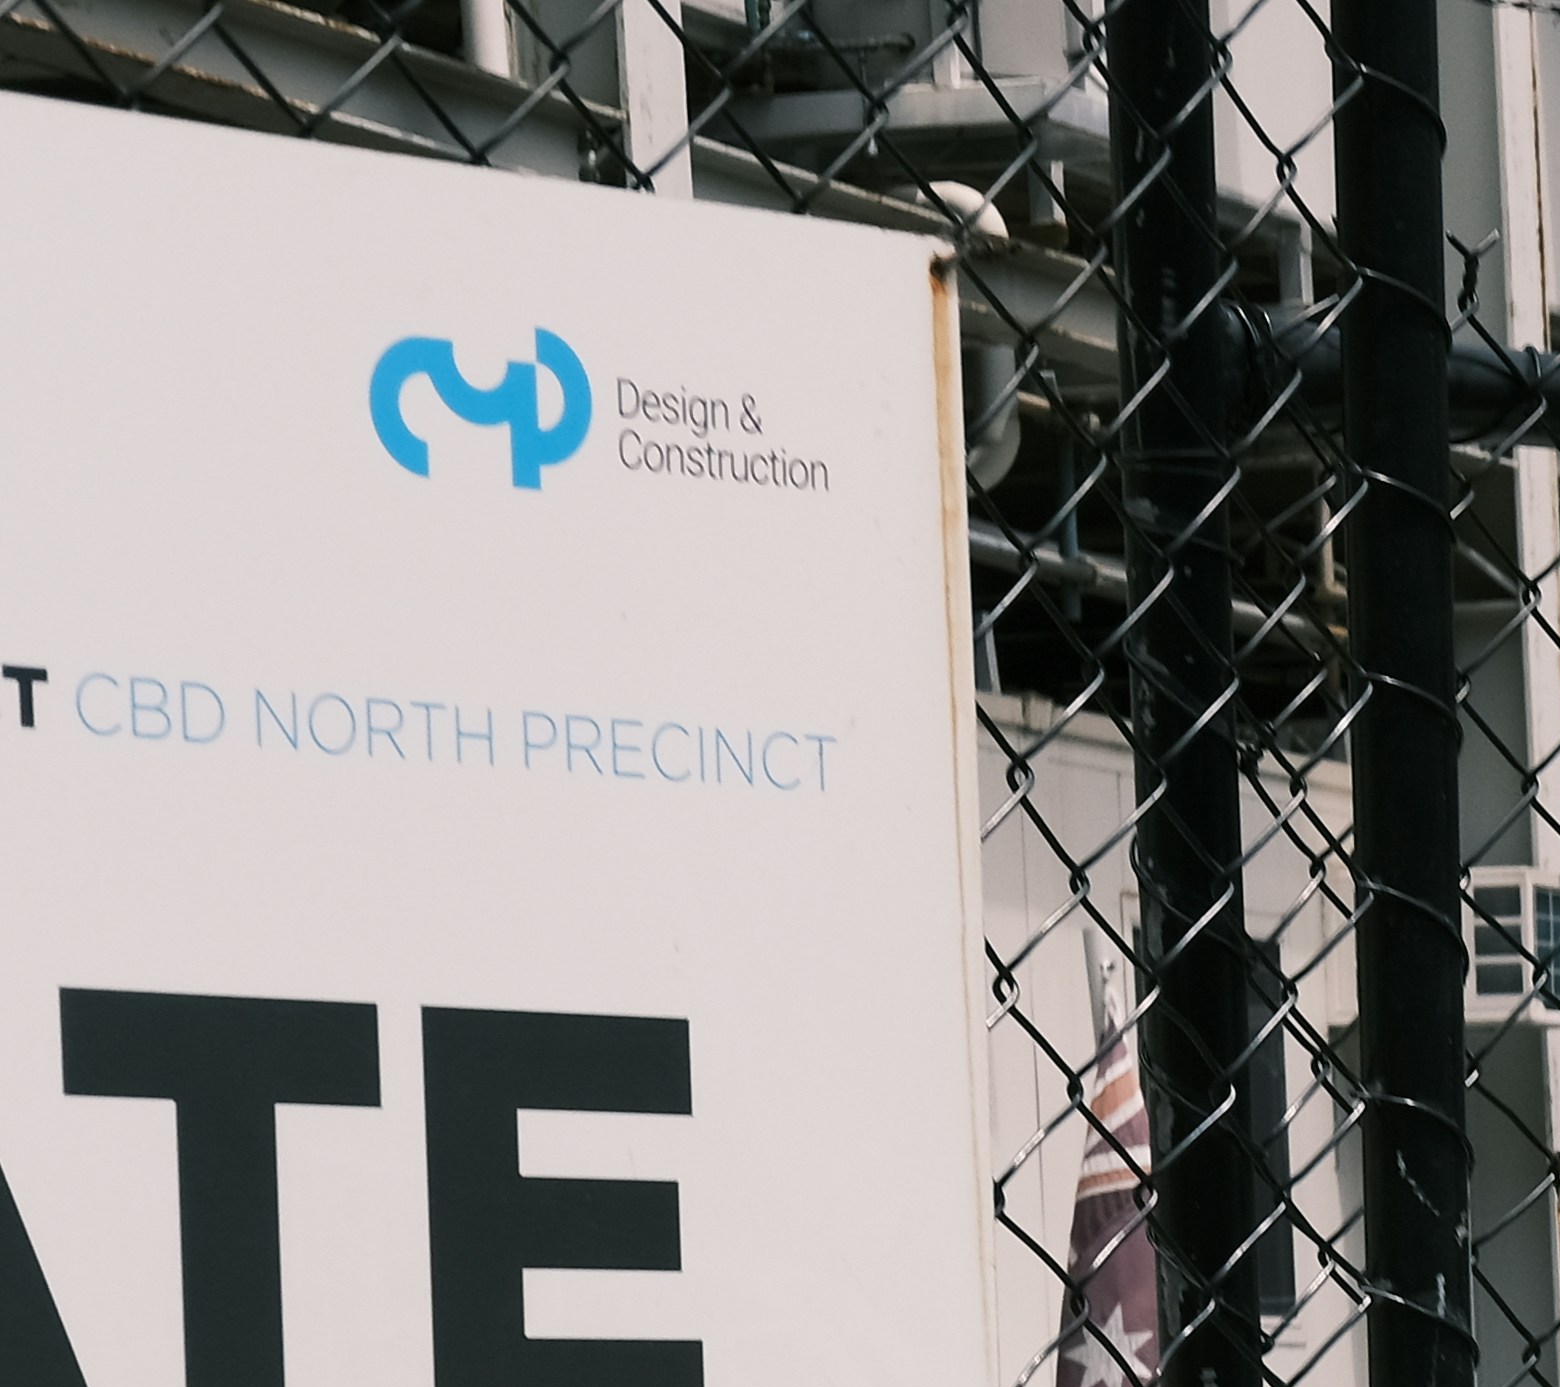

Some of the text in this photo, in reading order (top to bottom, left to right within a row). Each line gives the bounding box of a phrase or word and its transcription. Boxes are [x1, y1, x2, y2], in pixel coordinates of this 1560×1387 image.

[616, 376, 763, 440] Design &
[617, 428, 830, 492] Construction
[75, 671, 227, 746] CBD
[254, 687, 497, 768] NORTH
[522, 709, 839, 794] PRECINCT
